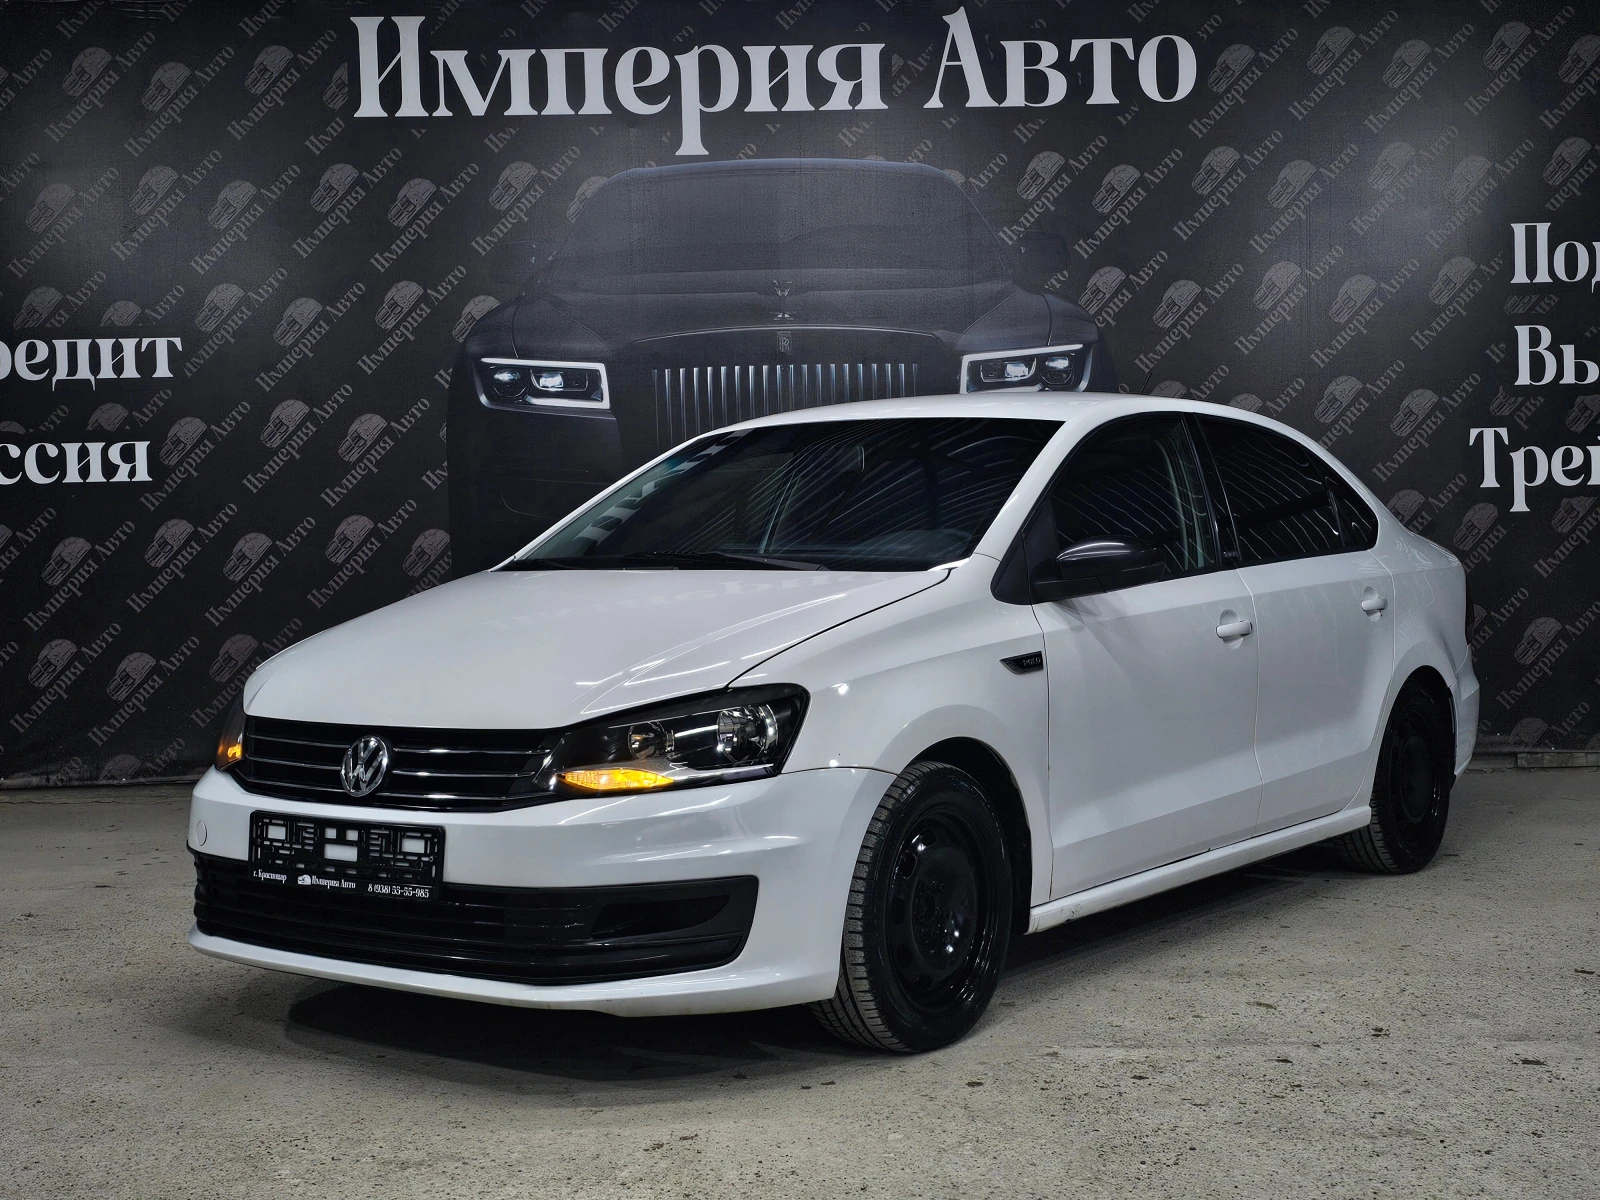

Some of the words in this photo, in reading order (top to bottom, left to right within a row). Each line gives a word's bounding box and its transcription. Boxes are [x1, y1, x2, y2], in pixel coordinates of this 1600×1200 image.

[11, 49, 52, 89] Авто
[44, 75, 121, 144] Империя
[115, 31, 157, 72] Авто
[123, 85, 199, 157] Империя
[194, 46, 236, 87] Авто
[226, 69, 301, 140] Империя
[296, 29, 338, 70] Авто
[349, 15, 889, 155] Империя
[923, 6, 1198, 108] Авто
[1188, 66, 1264, 138] Империя
[1259, 28, 1300, 68] Авто
[1288, 49, 1362, 121] Империя
[1358, 10, 1399, 50] Авто
[1364, 62, 1438, 135] Империя
[1434, 23, 1475, 63] Авто
[1463, 44, 1538, 116] Империя
[1534, 5, 1576, 46] Авто
[7, 210, 84, 279] Империя
[79, 167, 121, 207] Авто
[110, 190, 186, 262] Империя
[181, 150, 224, 190] Авто
[189, 205, 265, 276] Империя
[260, 165, 301, 205] Авто
[291, 189, 366, 259] Империя
[362, 148, 403, 189] Авто
[368, 200, 444, 274] Империя
[438, 162, 480, 203] Авто
[471, 185, 545, 256] Империя
[540, 146, 581, 186] Авто
[967, 152, 1008, 194] Авто
[997, 174, 1072, 247] Империя
[1069, 135, 1108, 175] Авто
[1072, 188, 1148, 260] Империя
[1143, 147, 1184, 188] Авто
[1172, 170, 1247, 242] Империя
[1242, 130, 1284, 170] Авто
[1249, 184, 1323, 254] Империя
[1319, 143, 1361, 184] Авто
[66, 270, 108, 312] Авто
[144, 285, 186, 325] Авто
[184, 306, 252, 378] Империя
[248, 266, 289, 307] Авто
[356, 304, 431, 375] Империя
[426, 264, 467, 305] Авто
[1129, 250, 1169, 290] Авто
[1134, 301, 1208, 374] Империя
[1203, 264, 1244, 305] Авто
[1234, 285, 1308, 356] Империя
[1303, 245, 1344, 285] Авто
[1310, 297, 1383, 368] Империя
[1378, 258, 1422, 299] Авто
[1410, 279, 1483, 349] Империя
[255, 322, 330, 392] Империя
[325, 281, 366, 322] Авто
[1189, 364, 1230, 400] Авто
[1366, 359, 1406, 398] Авто
[131, 389, 173, 427] Авто
[242, 421, 317, 494] Империя
[312, 383, 353, 425] Авто
[1266, 377, 1307, 417] Авто
[1372, 409, 1446, 483] Империя
[1441, 372, 1481, 412] Авто
[139, 439, 215, 512] Империя
[210, 400, 251, 441] Авто
[320, 435, 394, 508] Империя
[389, 398, 430, 438] Авто
[1428, 473, 1469, 513] Авто
[15, 507, 57, 548] Авто
[22, 561, 98, 632] Империя
[94, 521, 136, 562] Авто
[126, 542, 201, 614] Империя
[197, 502, 239, 543] Авто
[204, 555, 280, 626] Империя
[275, 515, 317, 556] Авто
[306, 538, 382, 608] Империя
[377, 500, 417, 539] Авто
[1490, 587, 1529, 627] Авто
[9, 662, 85, 735] Империя
[81, 622, 122, 663] Авто
[87, 676, 163, 747] Империя
[160, 636, 201, 677] Авто
[1495, 641, 1570, 710] Империя
[367, 883, 373, 892] 8
